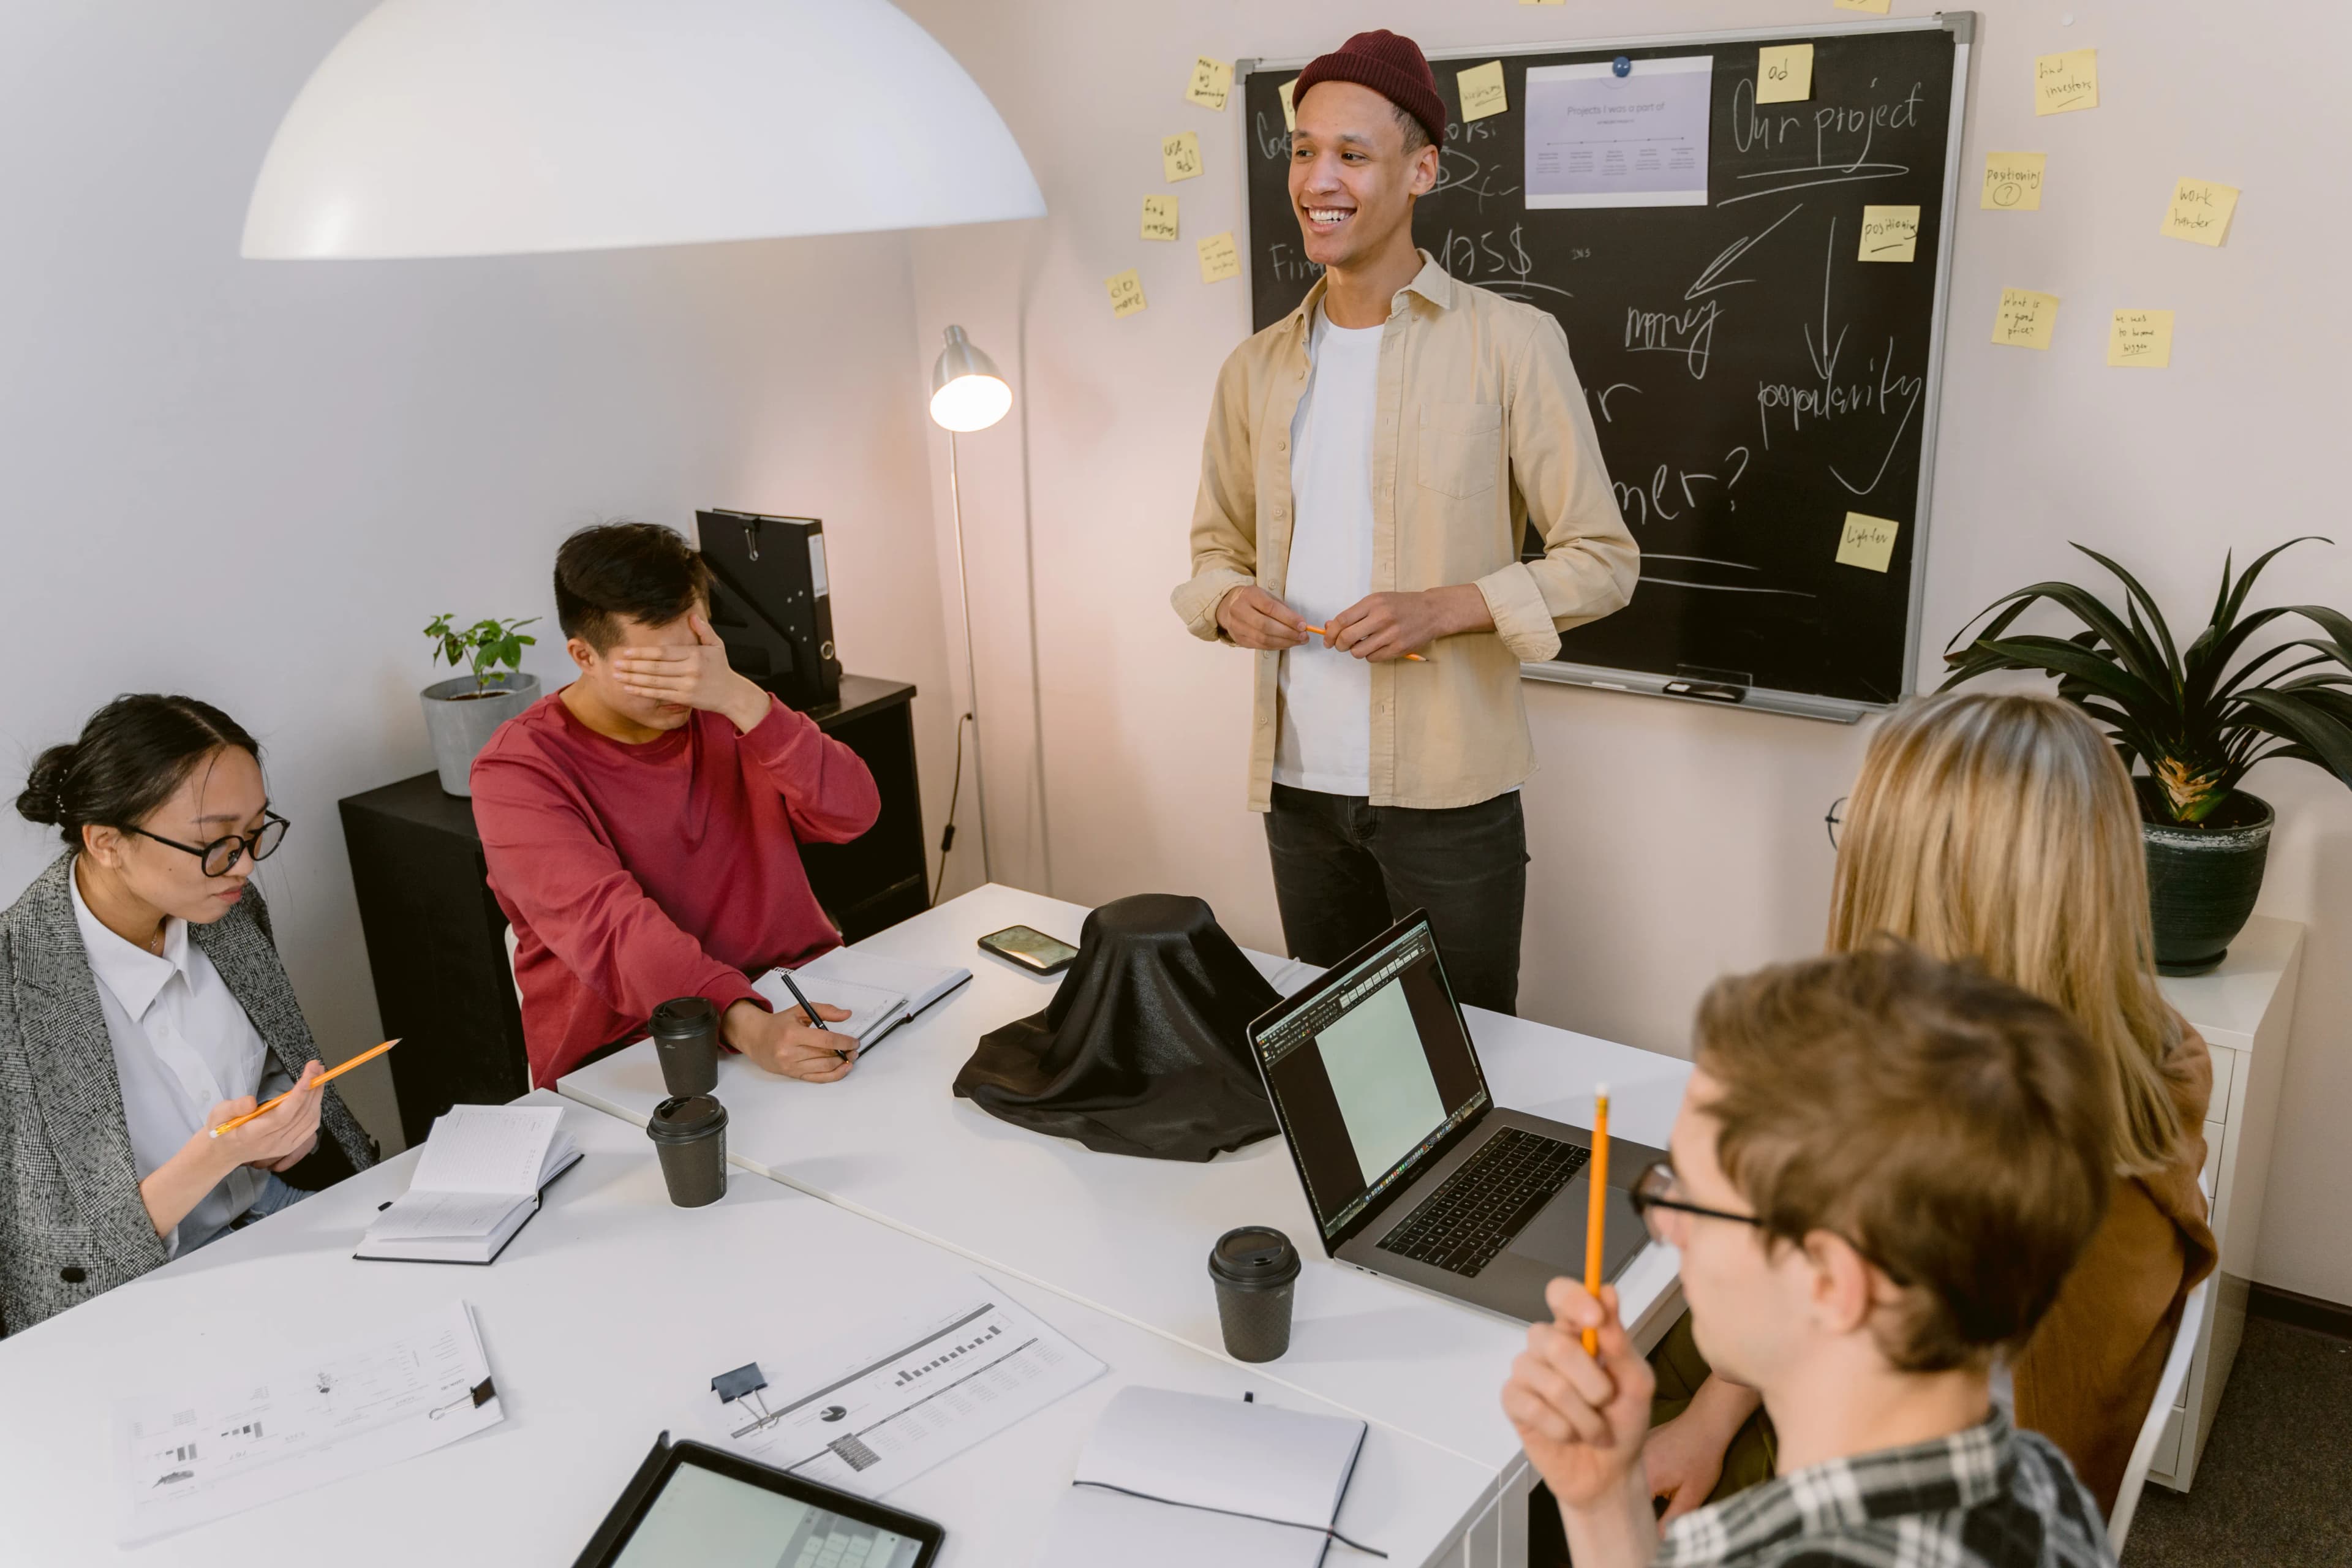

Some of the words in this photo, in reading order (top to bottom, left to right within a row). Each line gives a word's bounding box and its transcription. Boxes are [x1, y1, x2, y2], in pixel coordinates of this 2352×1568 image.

[1768, 58, 1788, 80] ad
[2046, 74, 2092, 99] investors
[1567, 105, 1602, 117] Projects
[1636, 103, 1654, 113] part
[1656, 101, 1665, 111] of
[1734, 78, 1801, 153] Our
[1814, 77, 1924, 173] project
[1986, 167, 2041, 190] positioning
[2180, 186, 2214, 208] work
[1758, 336, 1921, 495] popularity
